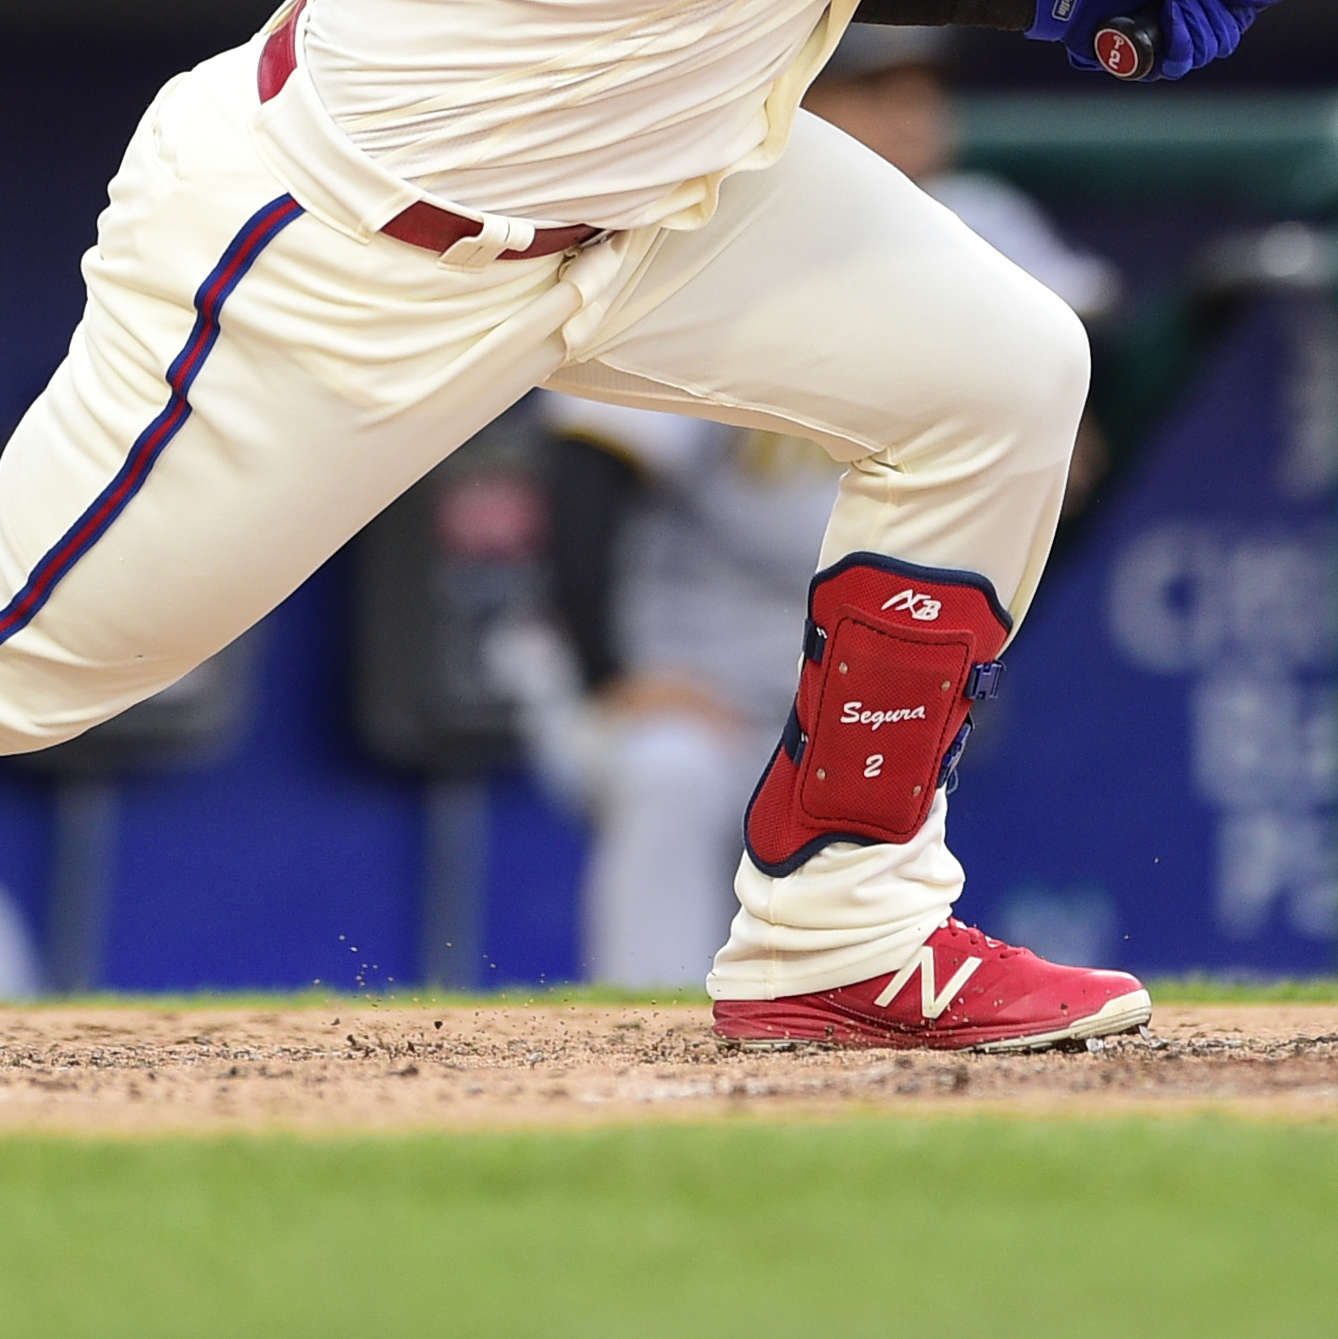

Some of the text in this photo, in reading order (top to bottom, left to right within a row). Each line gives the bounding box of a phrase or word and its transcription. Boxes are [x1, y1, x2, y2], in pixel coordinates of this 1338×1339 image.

[1108, 49, 1121, 70] 2
[840, 701, 926, 731] Segura
[863, 754, 884, 778] 2
[873, 945, 983, 1020] N
